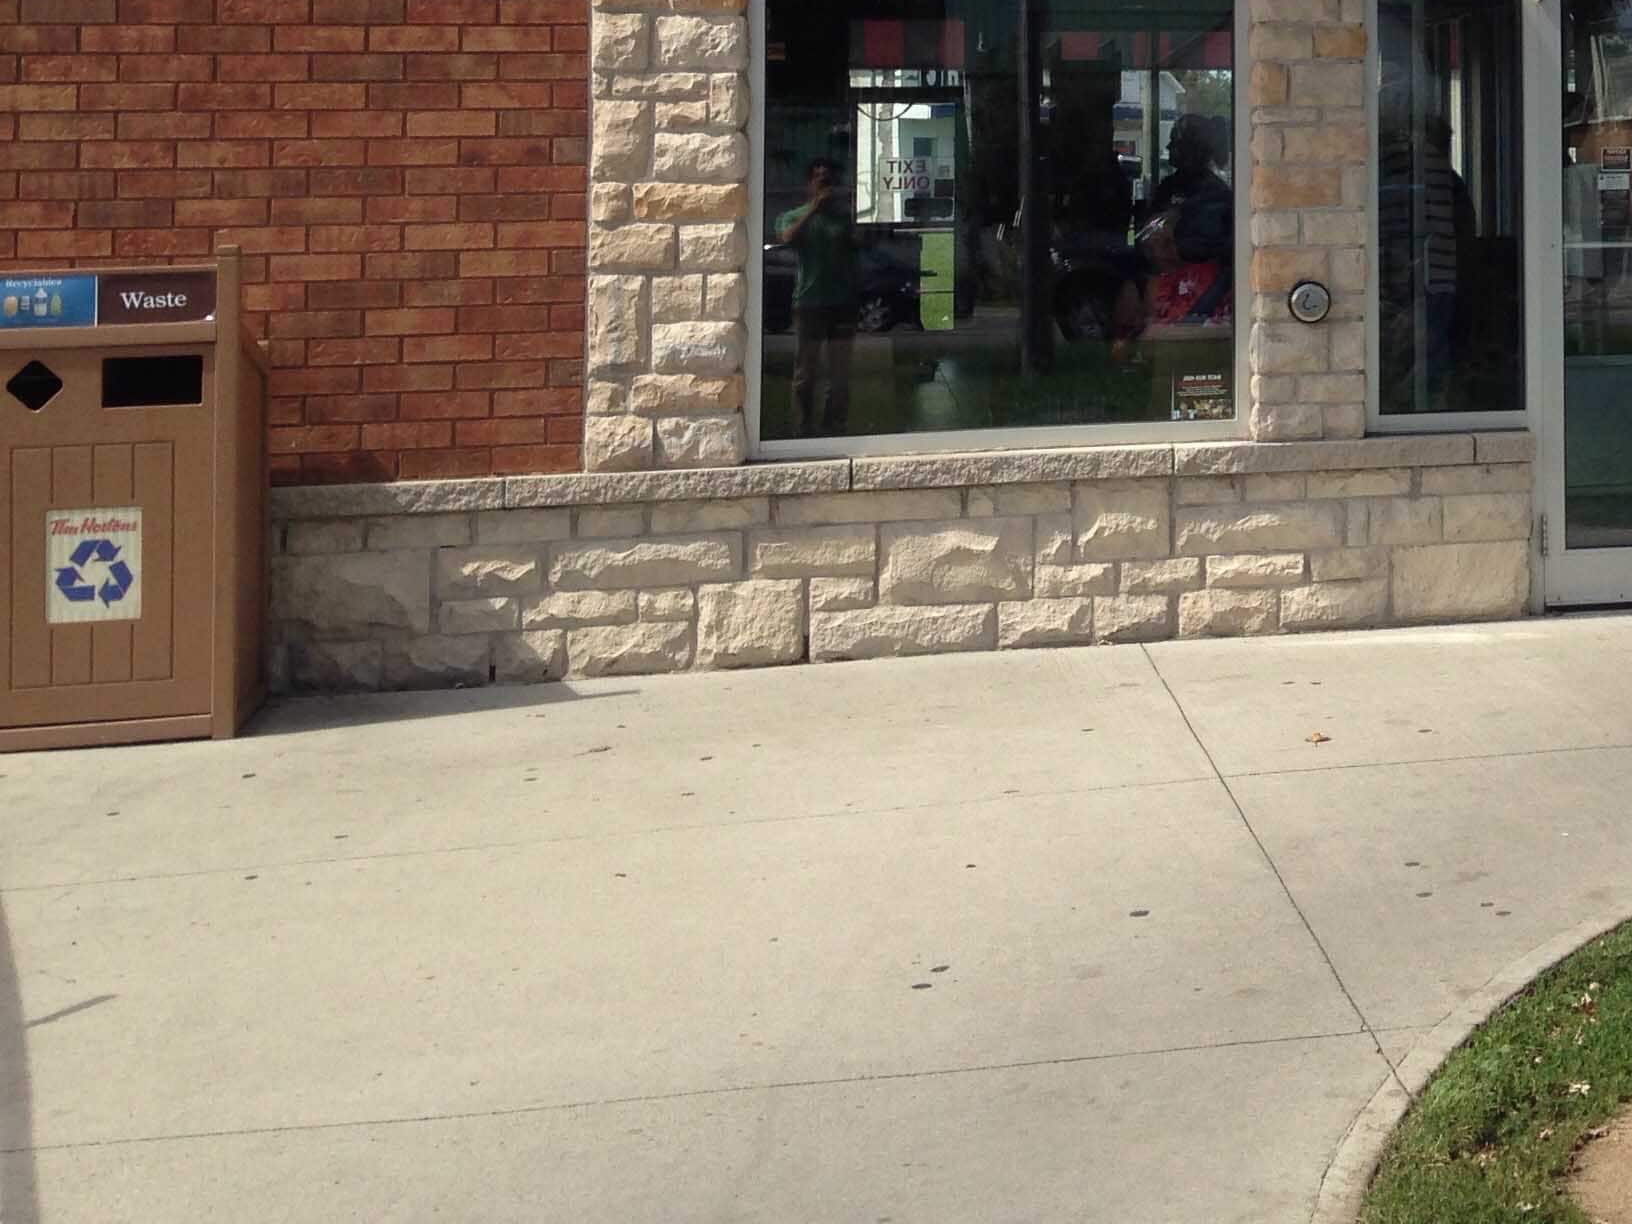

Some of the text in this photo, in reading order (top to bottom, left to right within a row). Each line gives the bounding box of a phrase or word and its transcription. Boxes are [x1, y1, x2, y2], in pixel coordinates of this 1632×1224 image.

[120, 292, 187, 310] Waste
[50, 517, 136, 536] Tim Hortons
